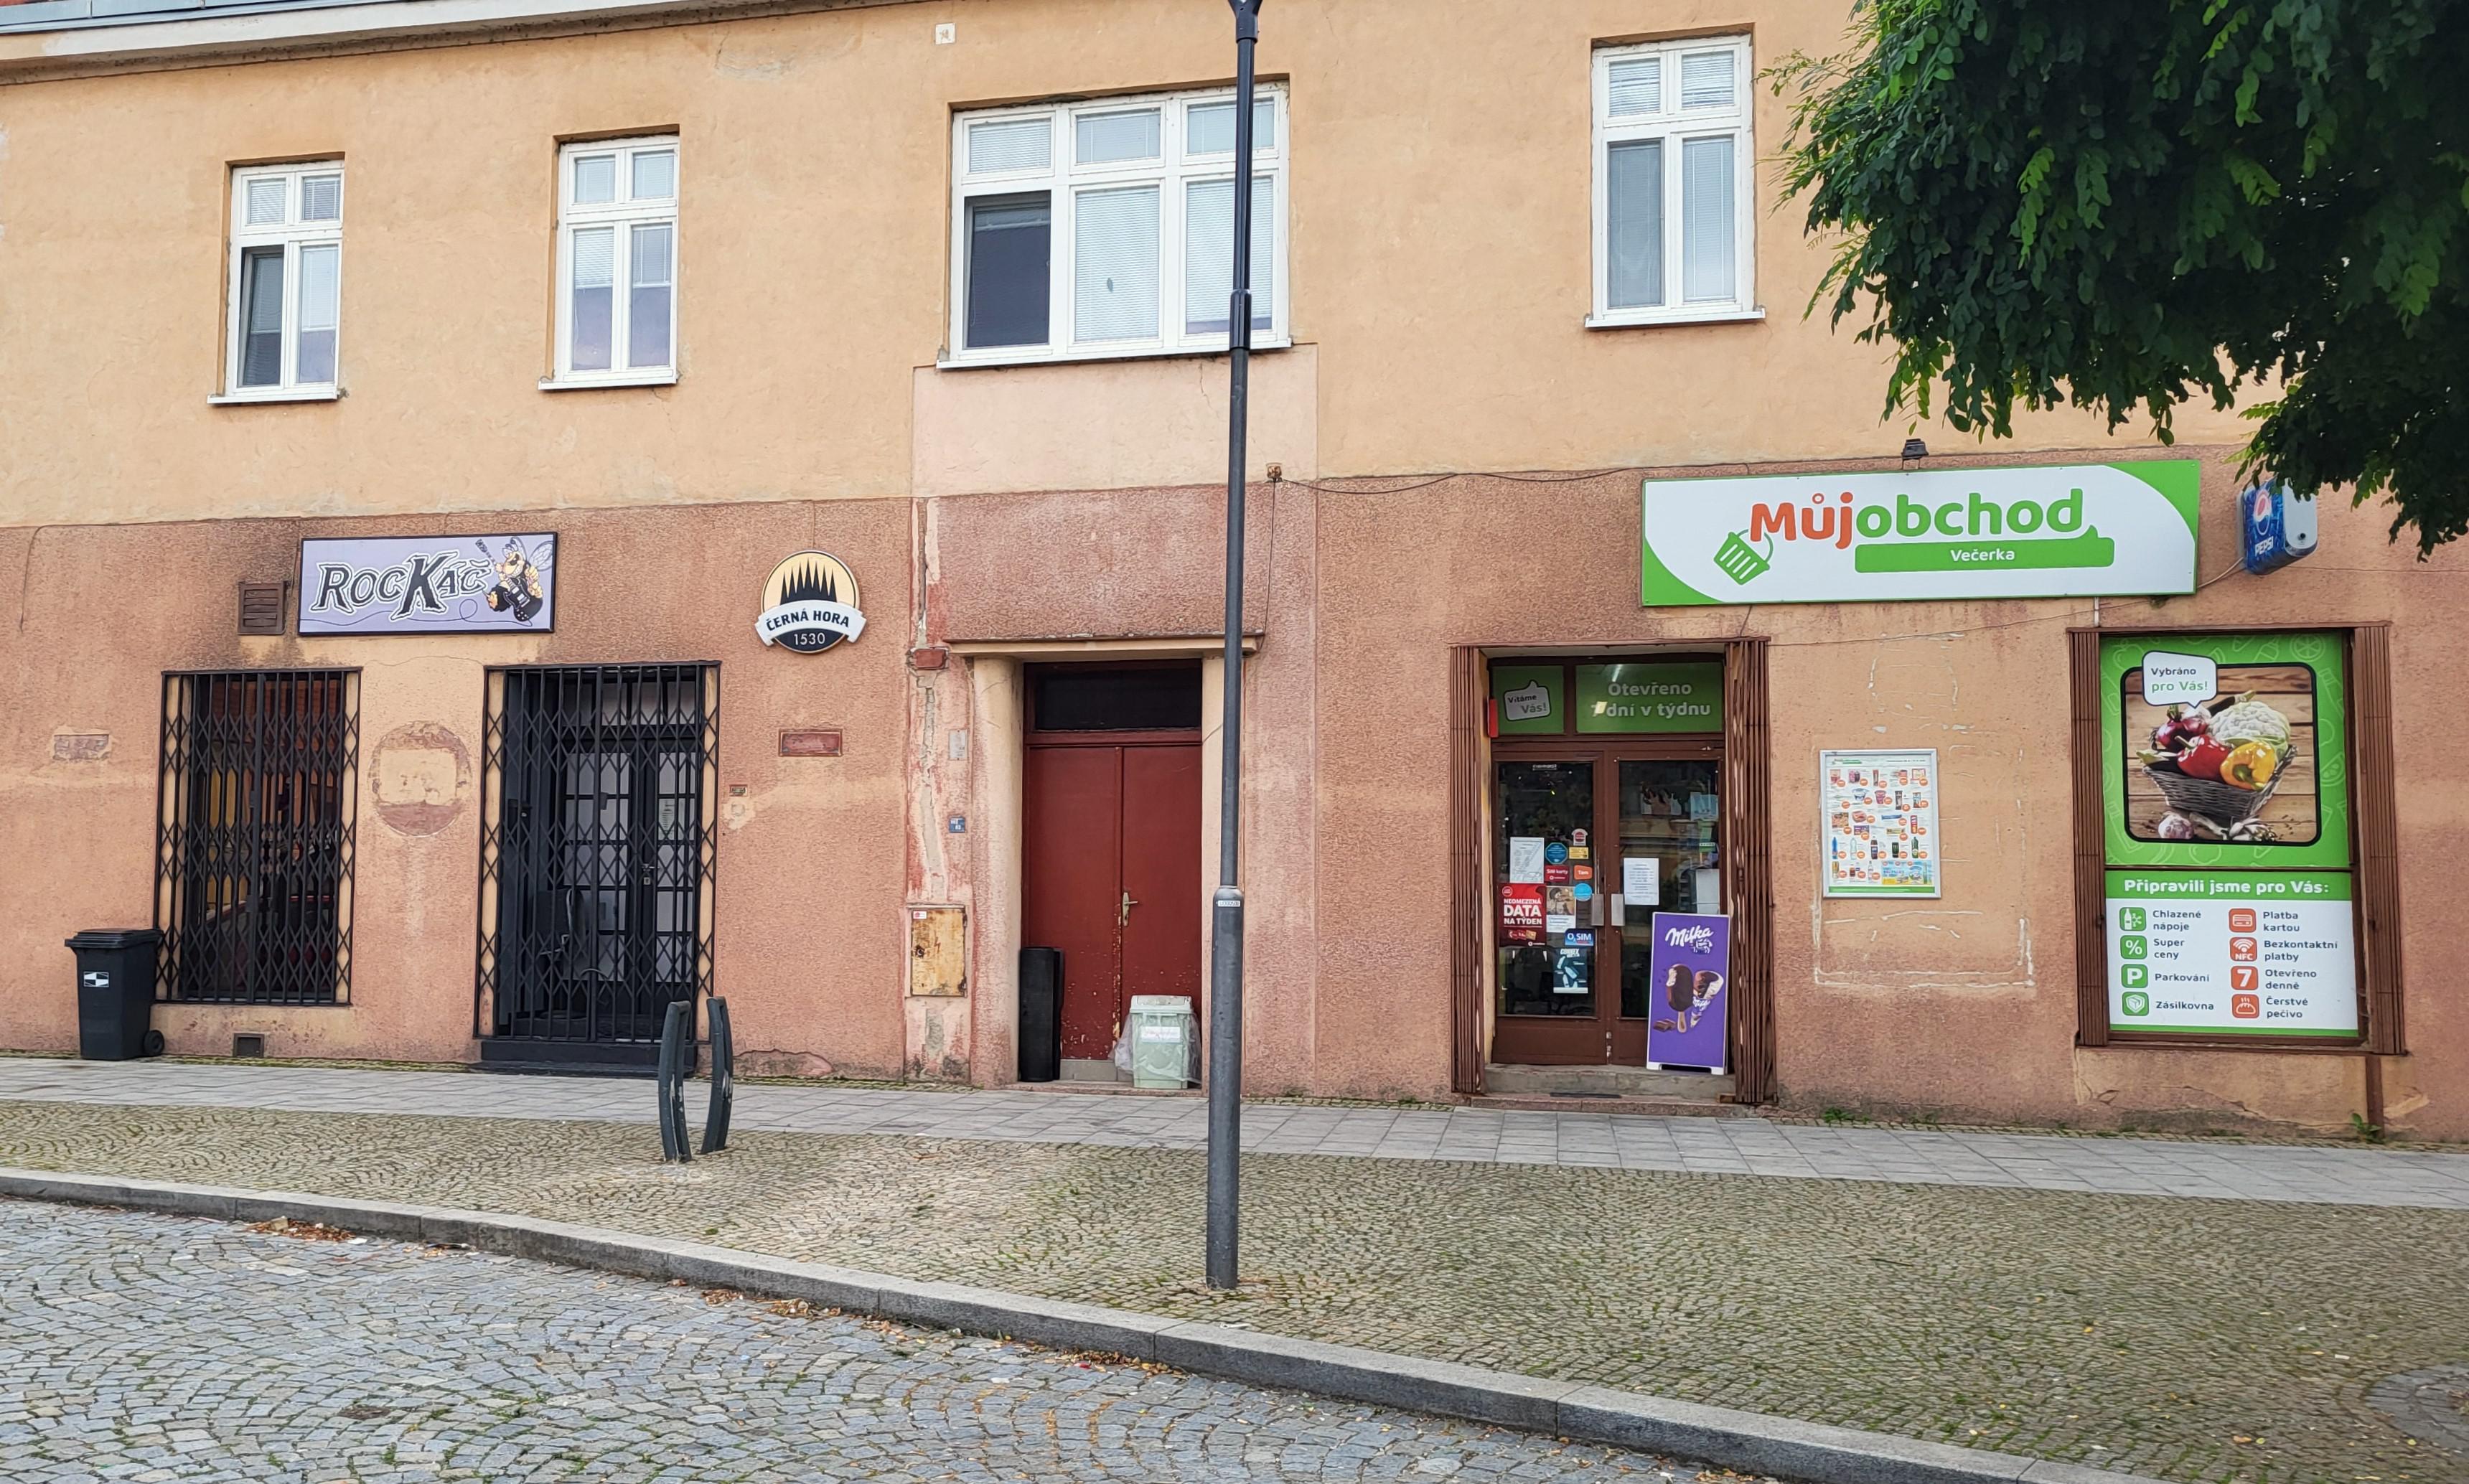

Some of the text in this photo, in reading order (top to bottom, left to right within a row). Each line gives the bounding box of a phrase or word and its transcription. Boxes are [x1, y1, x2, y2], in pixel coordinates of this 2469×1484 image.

[1950, 547, 2015, 562] Večerka
[766, 608, 849, 631] ČERNÁ HORA
[794, 632, 826, 646] 1530
[2151, 667, 2196, 677] Vybráno
[1608, 682, 1692, 696] Otevřeno
[2152, 680, 2208, 694] pro Vás!
[1521, 703, 1547, 714] Vás!
[1606, 703, 1635, 716] dní
[1641, 705, 1652, 716] v
[1657, 701, 1710, 718] týdnu
[2124, 879, 2330, 896] Připravili jsme pro Vás:
[1504, 904, 1542, 917] DATA
[2152, 909, 2202, 919] Chlazené
[2263, 911, 2298, 919] Platba
[1516, 916, 1542, 925] TÝDEN
[2153, 922, 2190, 931] nápoje
[2263, 924, 2300, 932] kartou
[1664, 925, 1714, 947] Milka
[2153, 938, 2185, 948] Super
[2264, 940, 2338, 949] Bezkontaktní
[2154, 952, 2179, 960] ceny
[2264, 953, 2299, 962] platby
[2127, 968, 2143, 985] P
[2155, 973, 2210, 982] Parkování
[2236, 969, 2252, 987] 7
[2265, 969, 2317, 978] Otevřeno
[2265, 981, 2300, 990] denně
[2155, 1001, 2214, 1010] Zásilkovna
[2266, 995, 2308, 1006] Čerstvé
[2267, 1010, 2303, 1019] pečivo
